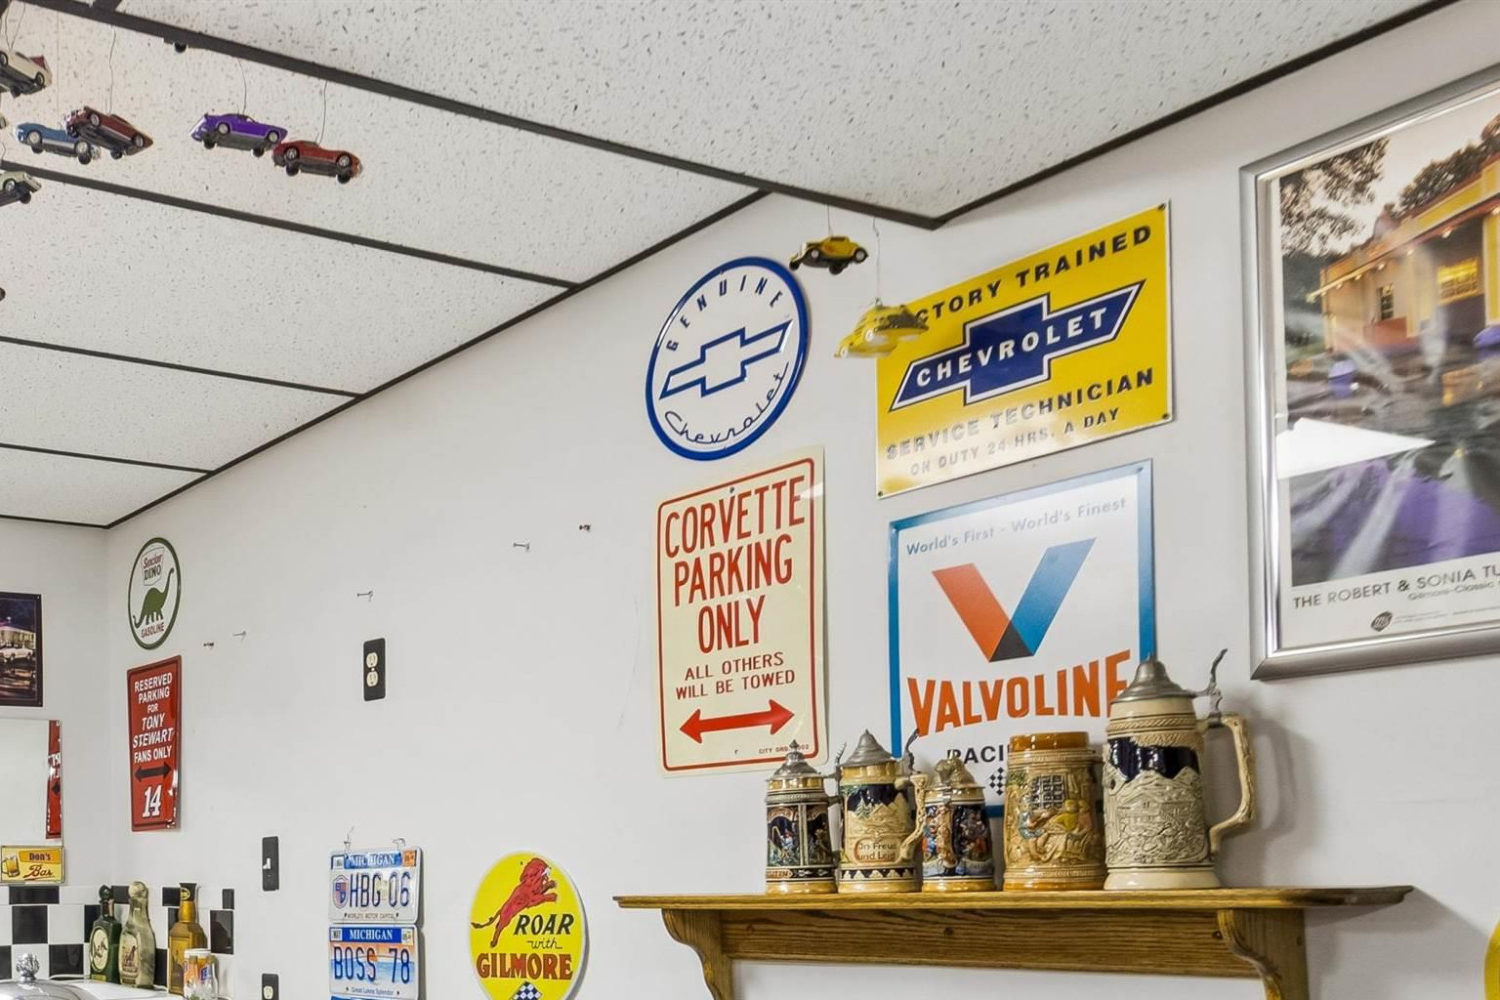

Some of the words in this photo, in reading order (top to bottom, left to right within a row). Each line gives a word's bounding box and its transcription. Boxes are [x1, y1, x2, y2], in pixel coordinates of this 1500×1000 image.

[914, 279, 1002, 324] CTORY
[1015, 224, 1152, 289] TRAINED
[666, 274, 783, 351] GENUINE
[916, 307, 1108, 388] CHEVROLET
[664, 361, 789, 445] Chevrolet
[886, 418, 981, 460] SERVICE
[990, 368, 1154, 429] TECHNICIAN
[938, 446, 980, 468] DUTY
[1014, 427, 1056, 448] HRS.
[1063, 421, 1076, 434] A
[1084, 407, 1120, 428] DAY
[664, 475, 805, 558] CORVETTE
[906, 527, 959, 556] World's
[963, 527, 995, 544] First
[1011, 510, 1071, 533] World's
[1077, 497, 1126, 519] Finest
[144, 564, 161, 581] DINO
[674, 533, 792, 607] PARKING
[1293, 594, 1322, 609] THE
[1327, 582, 1391, 604] ROBERT
[1398, 580, 1410, 592] &
[1416, 568, 1476, 590] SONIA
[141, 622, 165, 638] GASOLINE
[698, 594, 766, 654] ONLY
[684, 663, 713, 681] ALL
[721, 651, 784, 675] OTHERS
[134, 672, 172, 693] RESERVED
[138, 686, 170, 704] PARKING
[675, 683, 708, 700] WILL
[715, 678, 734, 694] BE
[741, 669, 795, 690] TOWED
[141, 713, 165, 730] TONY
[147, 702, 158, 713] FOR
[132, 727, 173, 748] STEWART
[134, 749, 152, 764] FANS
[153, 745, 173, 760] ONLY
[946, 744, 1010, 764] RACI
[141, 784, 162, 818] 14
[29, 852, 51, 861] Don's
[350, 854, 395, 867] MICHIGAN
[349, 872, 382, 907] HBG
[388, 871, 411, 907] 06
[349, 929, 394, 940] MICHIGAN
[513, 913, 575, 936] ROAR
[527, 937, 563, 950] with
[334, 946, 377, 982] BOSS
[388, 947, 410, 984] 78
[476, 952, 574, 981] GILMORE
